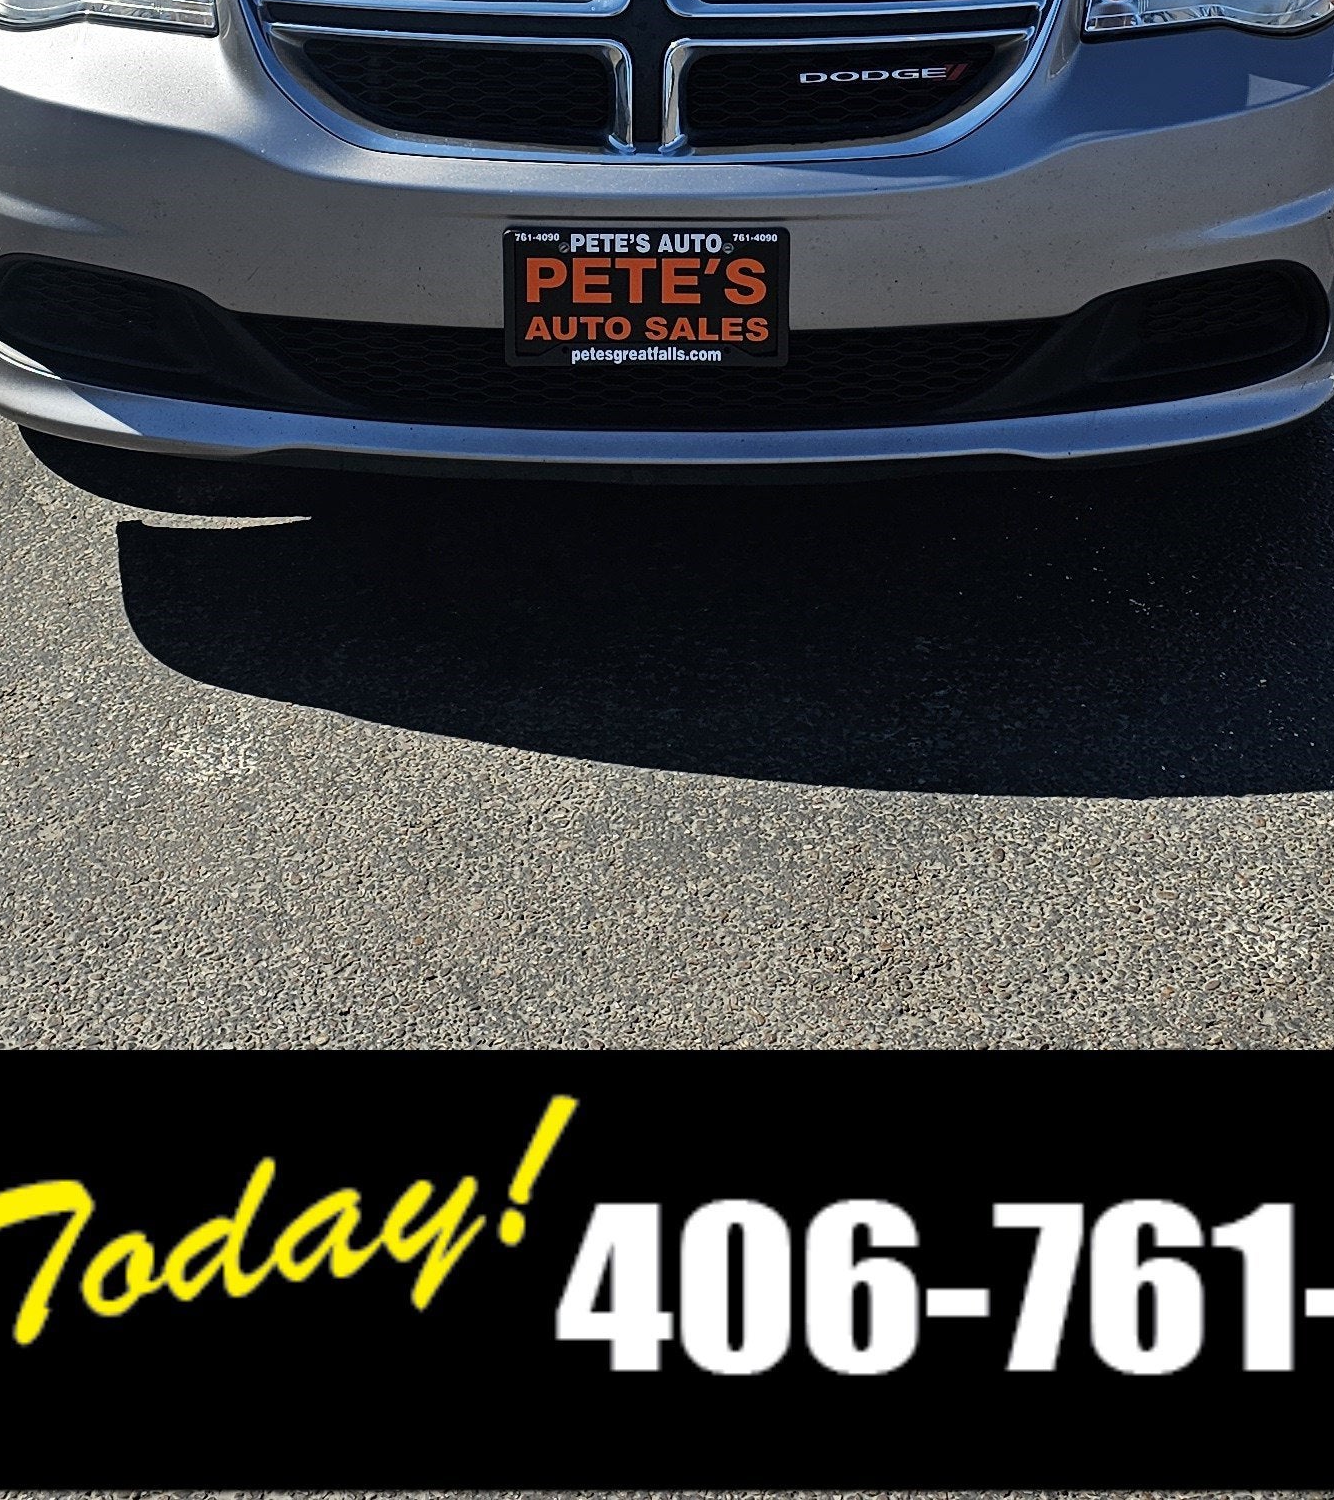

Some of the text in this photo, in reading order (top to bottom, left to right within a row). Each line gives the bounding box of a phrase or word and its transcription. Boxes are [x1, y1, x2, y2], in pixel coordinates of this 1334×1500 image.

[799, 67, 947, 84] DODGE
[514, 232, 560, 242] 761-4090
[570, 233, 723, 254] PETE'S AUTO
[733, 233, 778, 243] 761-4090
[526, 257, 767, 306] PETE'S
[524, 316, 769, 342] AUTO SALES
[571, 347, 722, 365] petesgreatfalls.com
